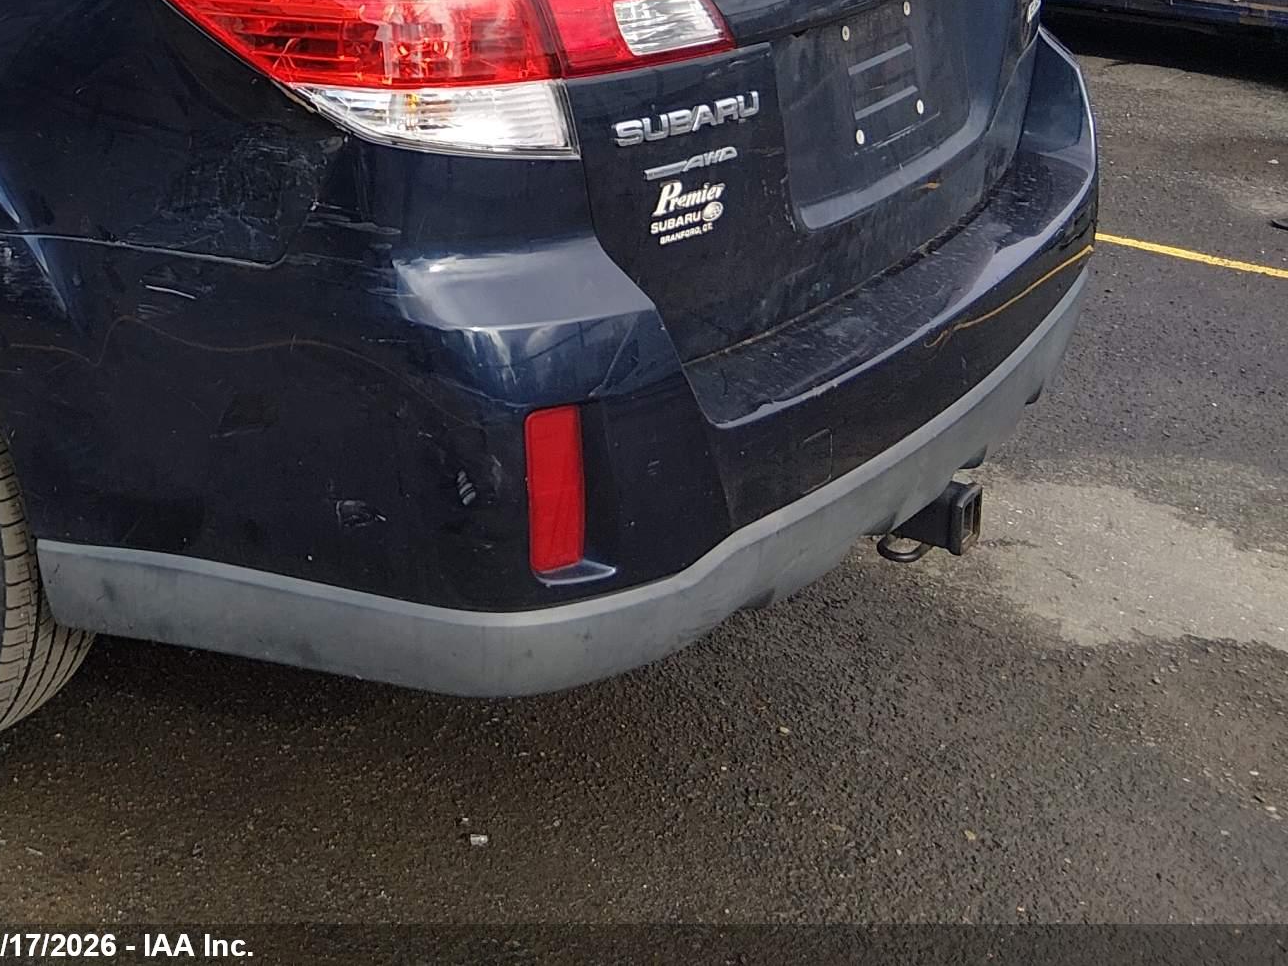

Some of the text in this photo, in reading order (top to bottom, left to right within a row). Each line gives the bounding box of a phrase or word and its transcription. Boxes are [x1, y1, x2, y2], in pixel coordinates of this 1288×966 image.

[614, 90, 760, 147] SUBARU
[682, 146, 738, 172] AWD
[651, 179, 726, 217] Premier
[650, 210, 702, 235] SUBARU
